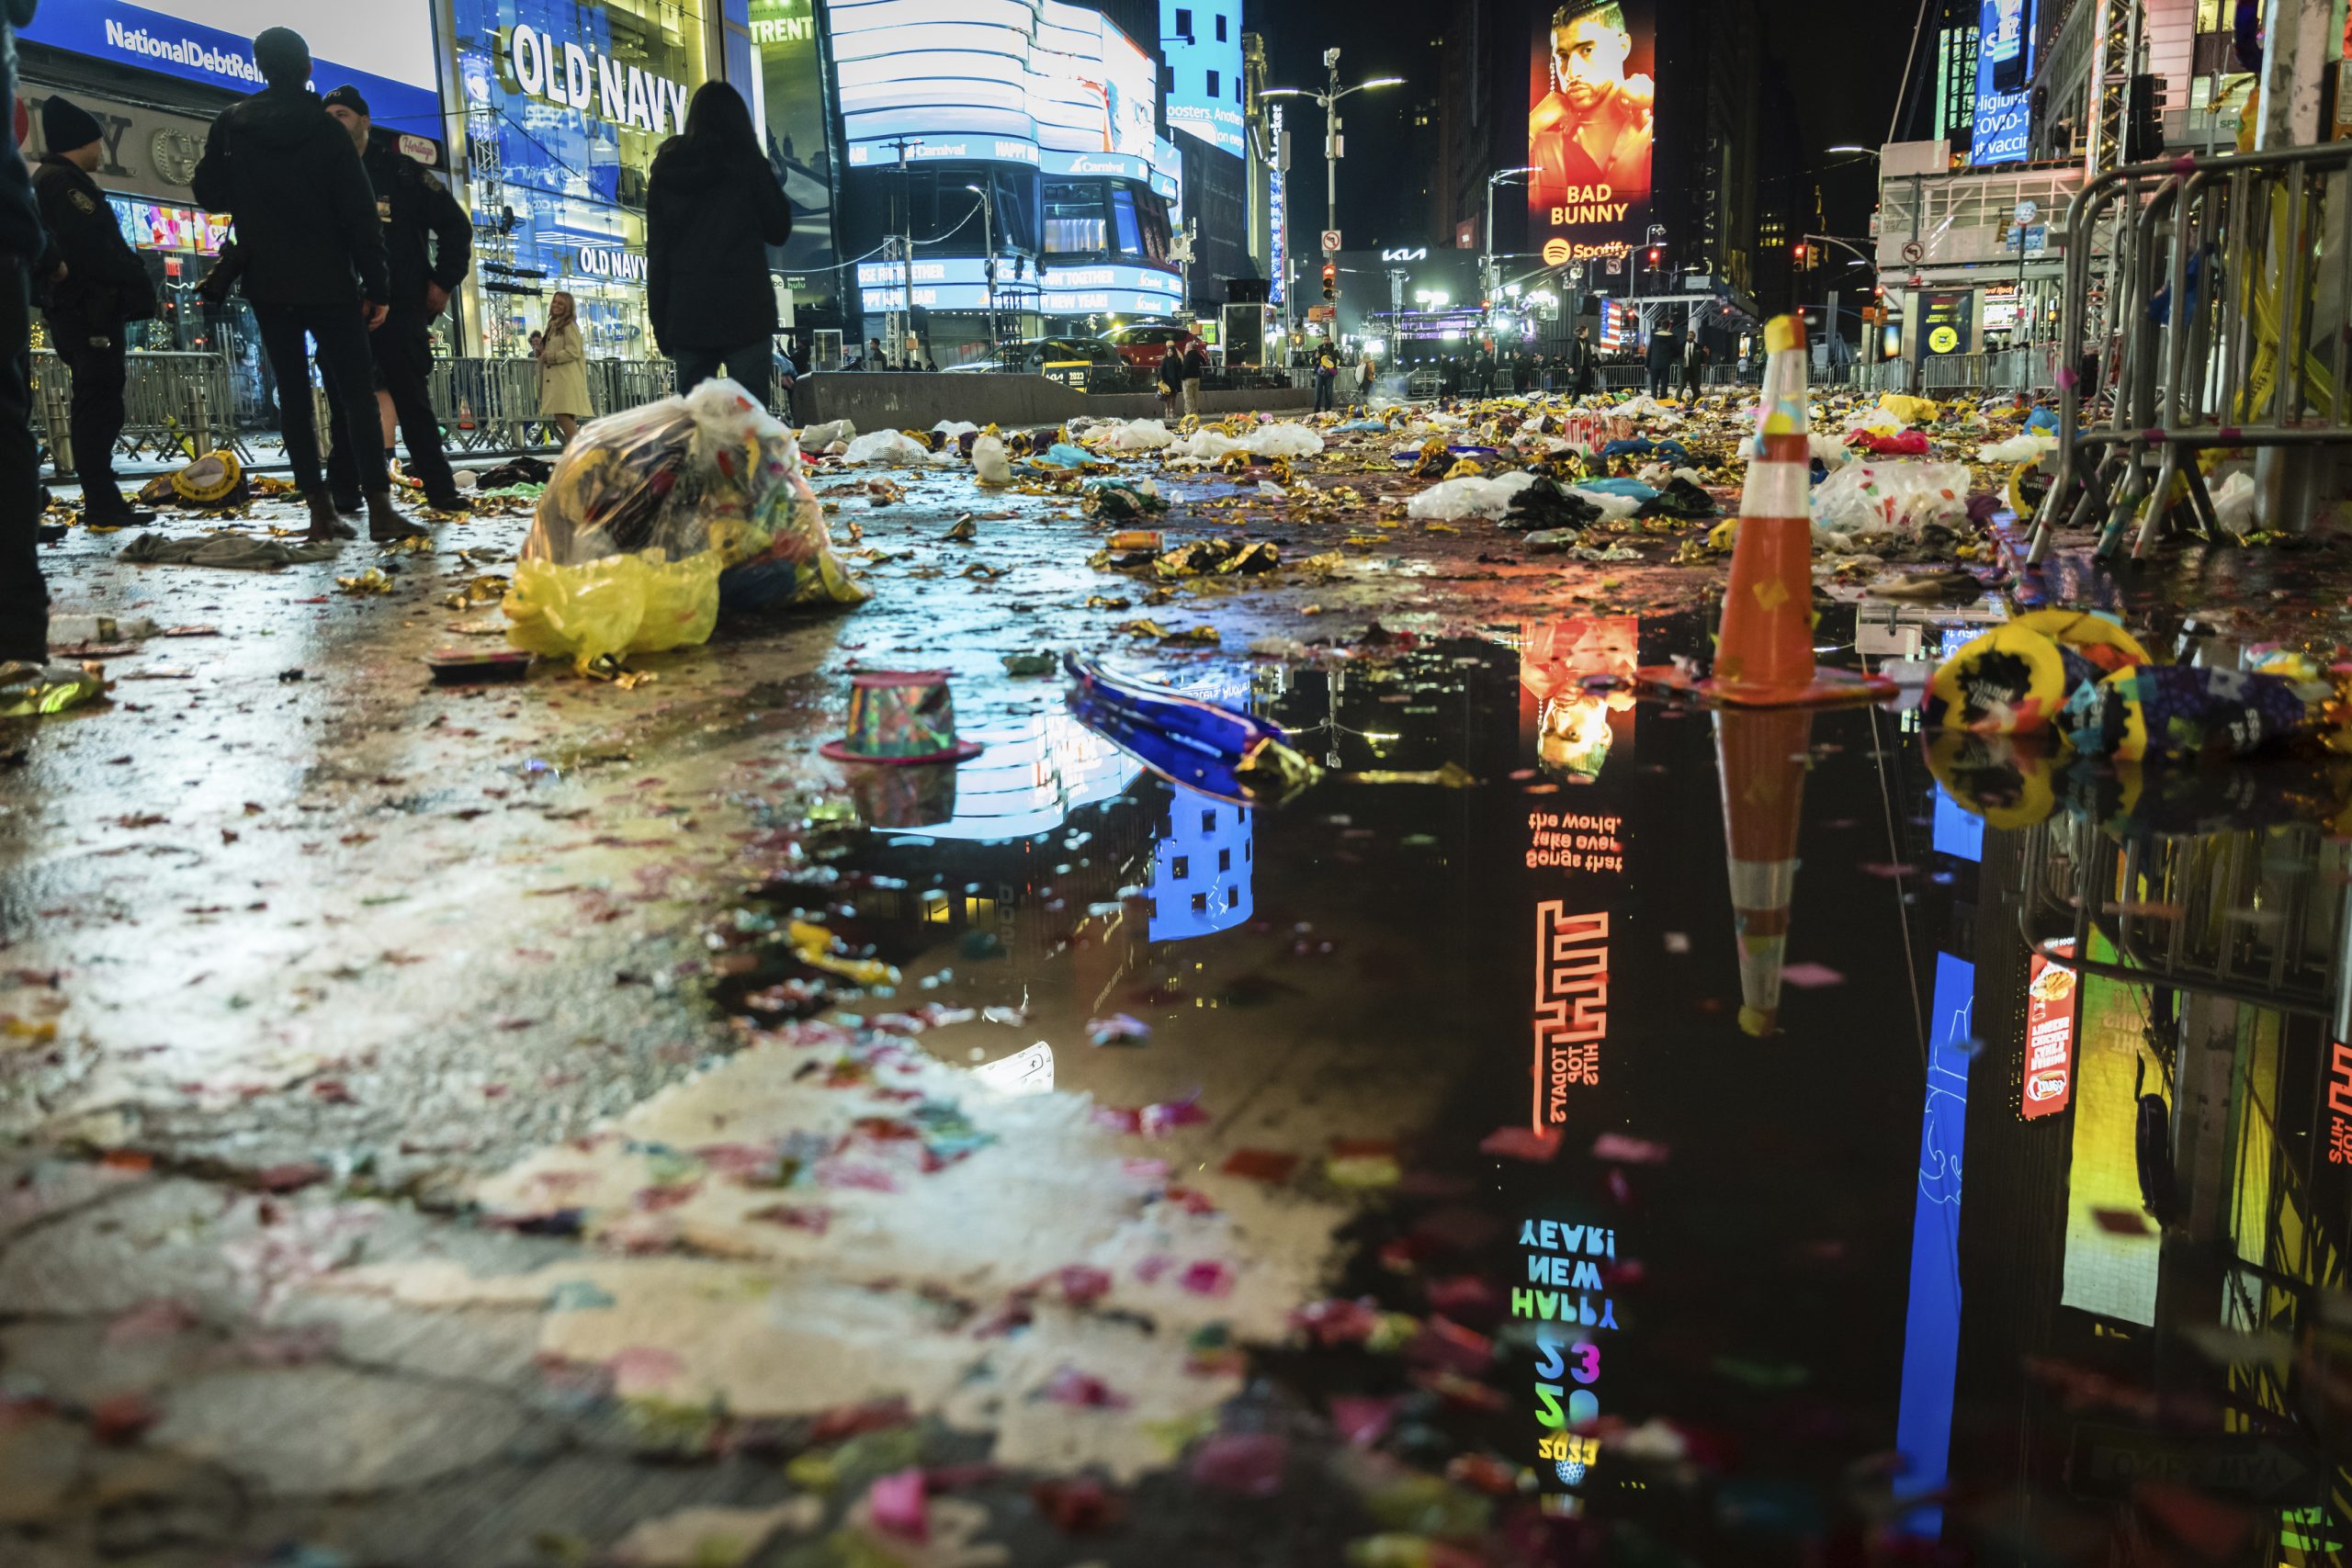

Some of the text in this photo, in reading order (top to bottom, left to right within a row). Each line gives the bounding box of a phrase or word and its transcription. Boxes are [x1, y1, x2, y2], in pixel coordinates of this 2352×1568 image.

[749, 17, 814, 44] TRENT
[513, 24, 687, 135] OLD NAVY
[401, 136, 435, 161] Heritage
[917, 143, 967, 157] Carnival
[1082, 162, 1125, 174] Carnival
[1566, 184, 1612, 204] BAD
[1551, 203, 1629, 225] BUNNY
[1573, 241, 1629, 261] Spotify
[581, 247, 647, 279] OLD NAVY
[897, 264, 944, 281] TOETHER
[911, 289, 936, 305] EAR!
[1996, 286, 2014, 295] Rock
[1069, 372, 1084, 380] 2023
[2328, 1116, 2346, 1165] HITS
